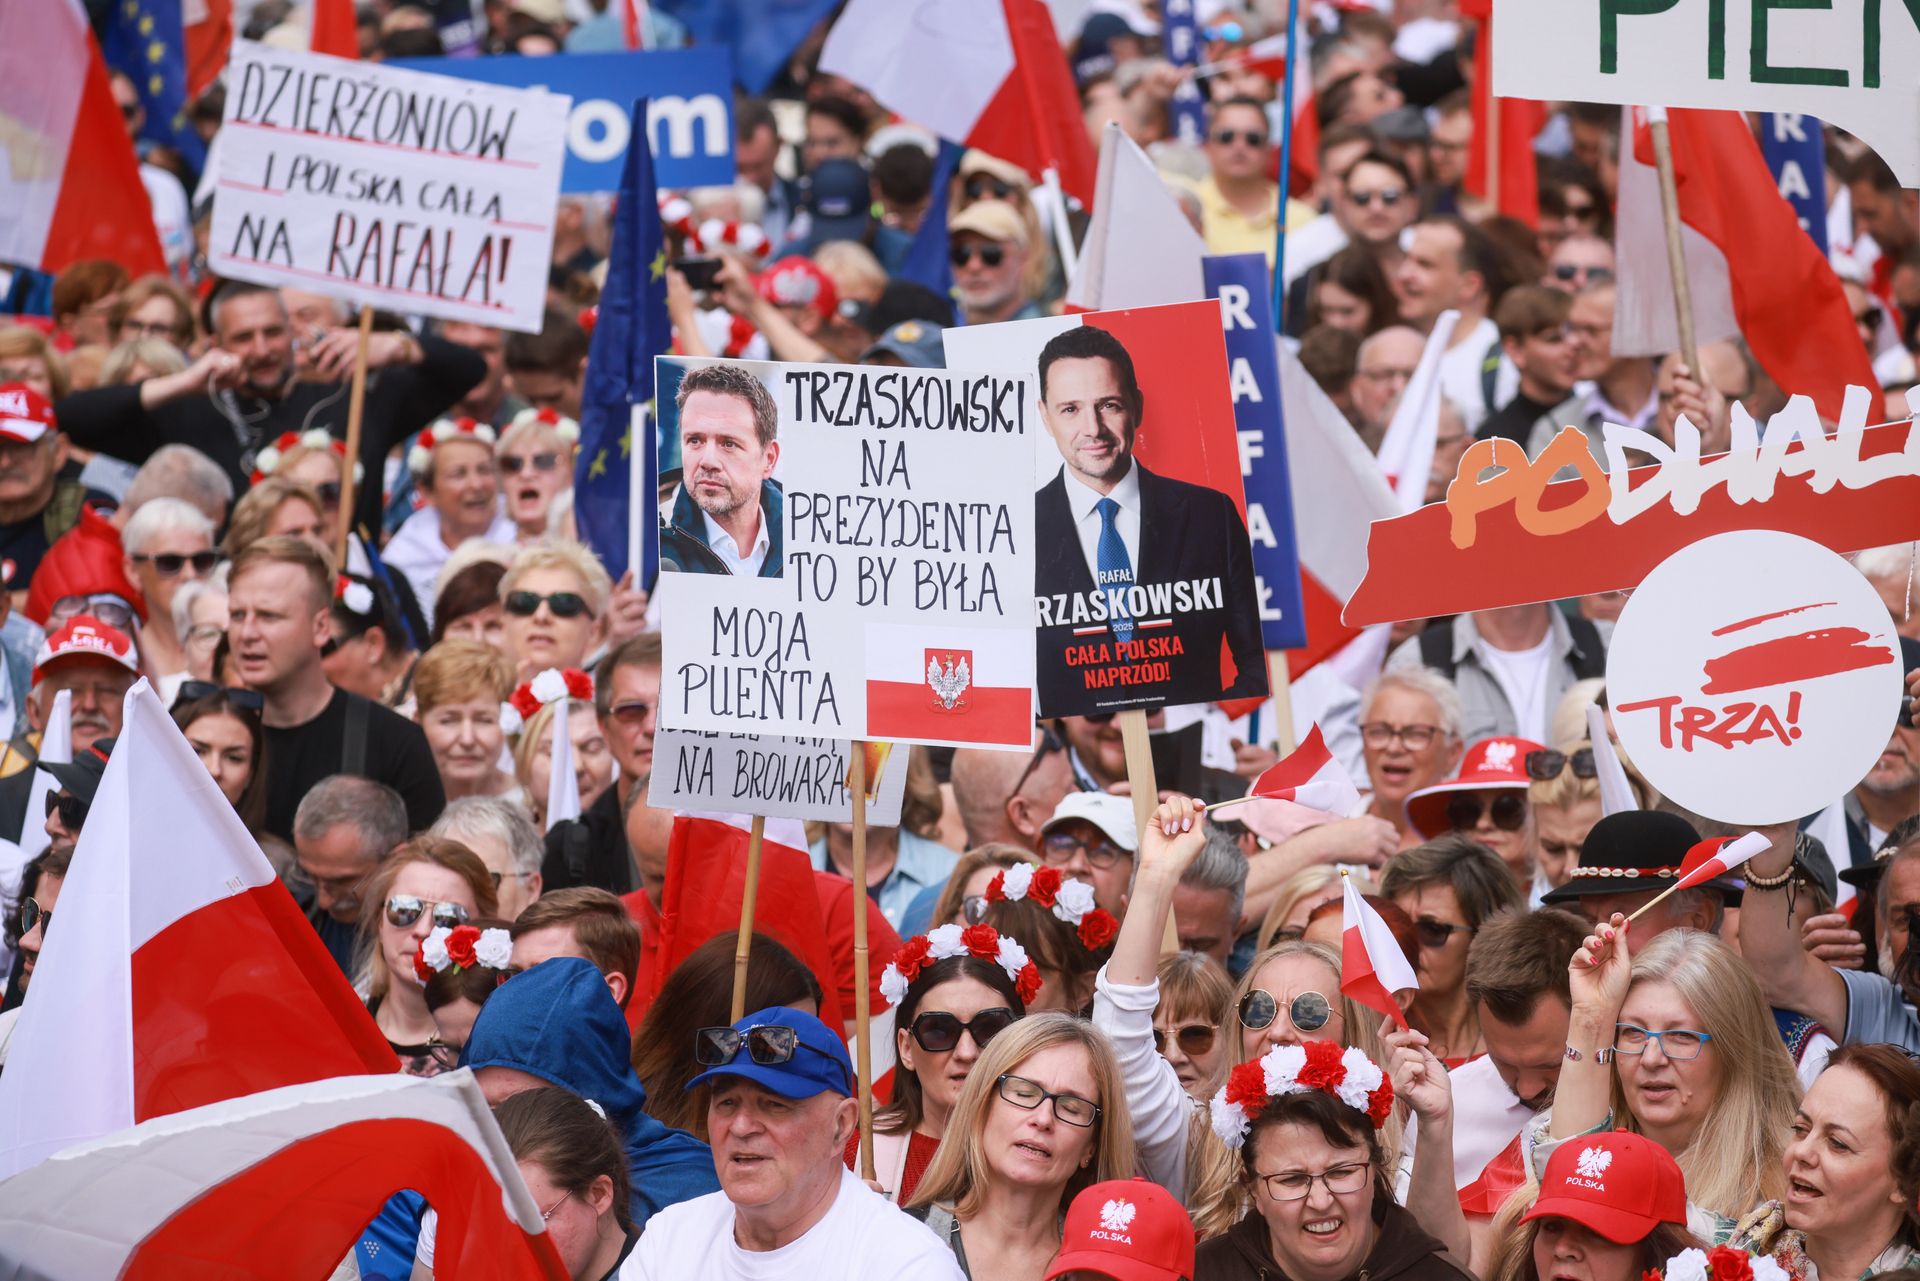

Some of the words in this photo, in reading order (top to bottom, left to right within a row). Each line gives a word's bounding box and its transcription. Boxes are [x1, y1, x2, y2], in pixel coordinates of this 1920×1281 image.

[236, 62, 518, 161] DZIERŻONIÓW
[567, 93, 729, 163] om
[263, 151, 275, 190] I
[286, 154, 404, 206] POLSKA
[419, 180, 503, 221] CAŁA
[231, 211, 294, 268] NA
[327, 210, 514, 309] RAFAŁA!
[786, 371, 1025, 435] TRZASKOWSKI
[860, 438, 912, 490] NA
[1446, 384, 1920, 550] PODHAL
[788, 492, 1016, 555] PREZYDENTA
[789, 552, 837, 602] TO
[856, 556, 897, 607] BY
[913, 559, 1004, 616] BYŁA
[1035, 577, 1224, 628] RZASKOWSKI
[1099, 568, 1133, 584] RAFAŁ
[711, 606, 811, 673] MOJA
[1064, 643, 1112, 667] CAŁA
[1114, 635, 1185, 661] POLSKA
[1112, 622, 1135, 632] 2025
[677, 663, 841, 726] PUENTA
[1084, 658, 1171, 689] NAPRZÓD!
[1616, 691, 1803, 752] TRZA!
[673, 745, 713, 797] NA
[731, 749, 845, 807] BROWARA
[1564, 1176, 1605, 1192] POLSKA
[1090, 1230, 1132, 1246] POLSKA
